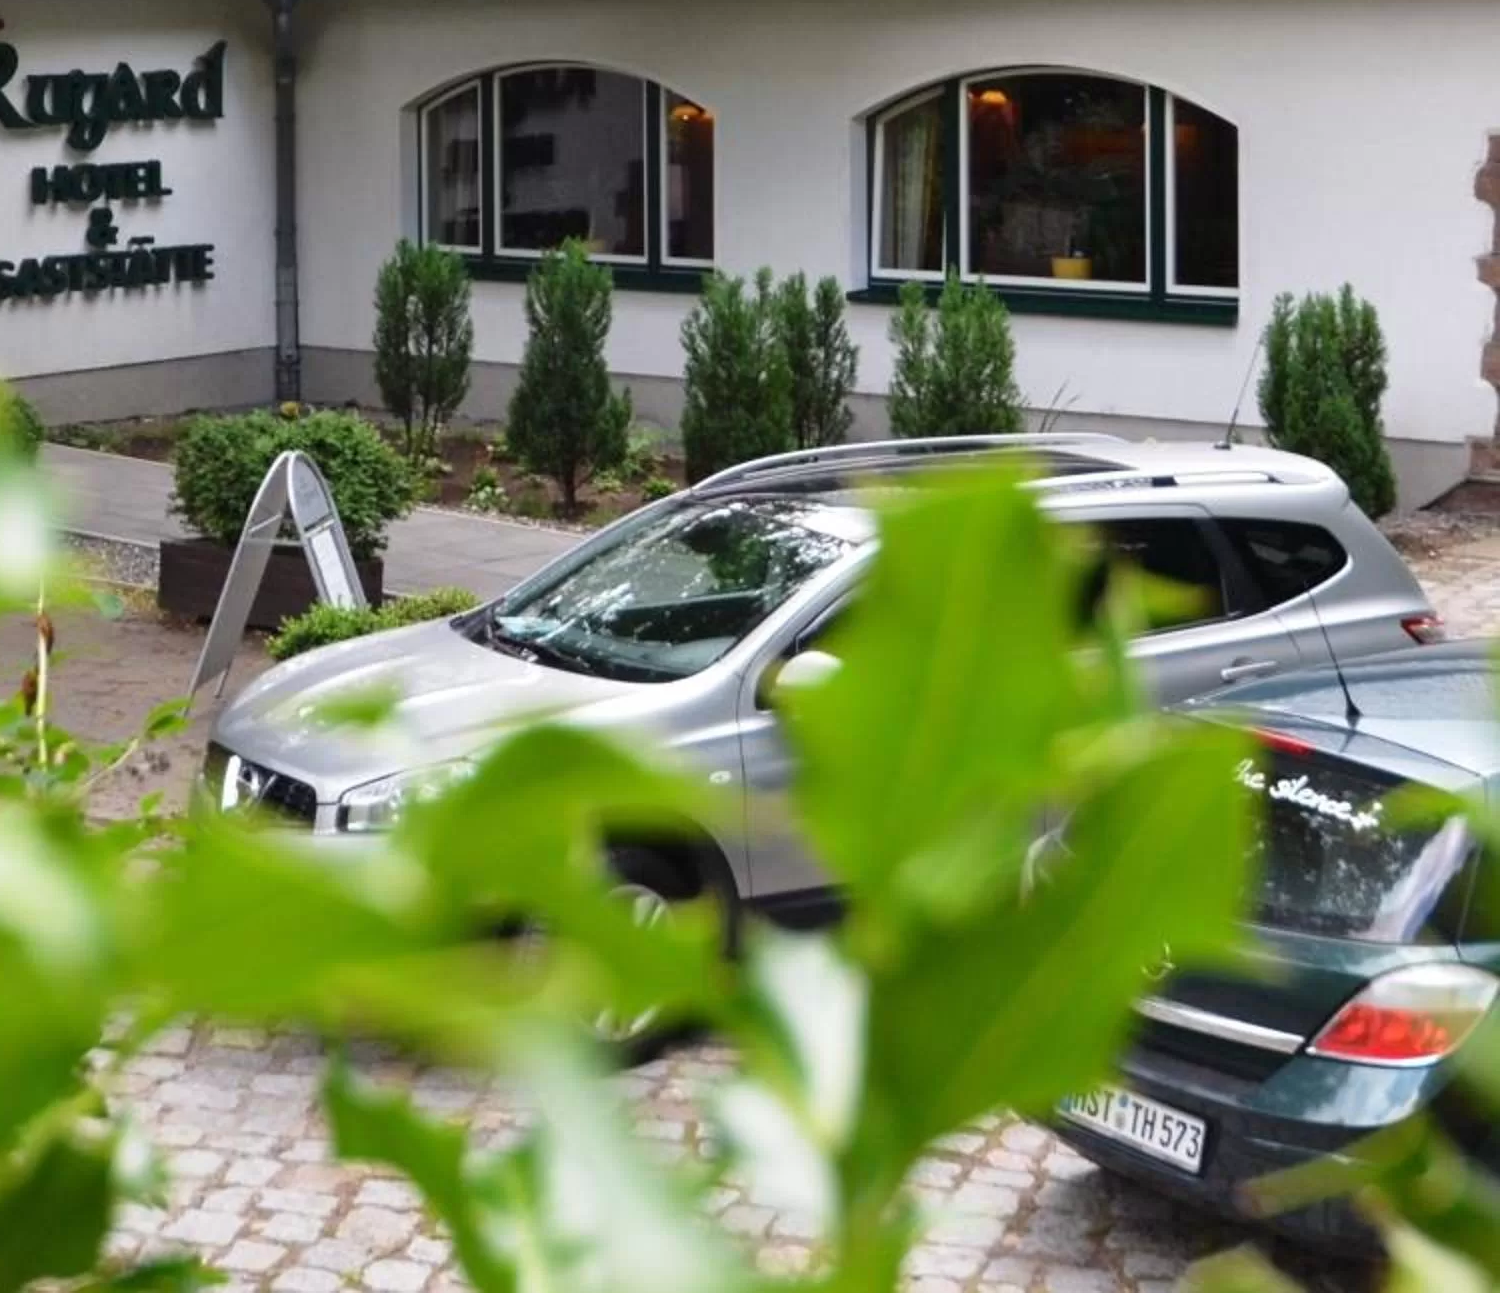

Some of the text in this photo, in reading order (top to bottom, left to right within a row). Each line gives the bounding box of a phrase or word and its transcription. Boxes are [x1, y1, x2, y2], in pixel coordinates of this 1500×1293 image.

[29, 159, 173, 205] HOTEL
[85, 206, 119, 247] &
[1130, 1100, 1158, 1141] TH
[1159, 1113, 1202, 1159] 573
